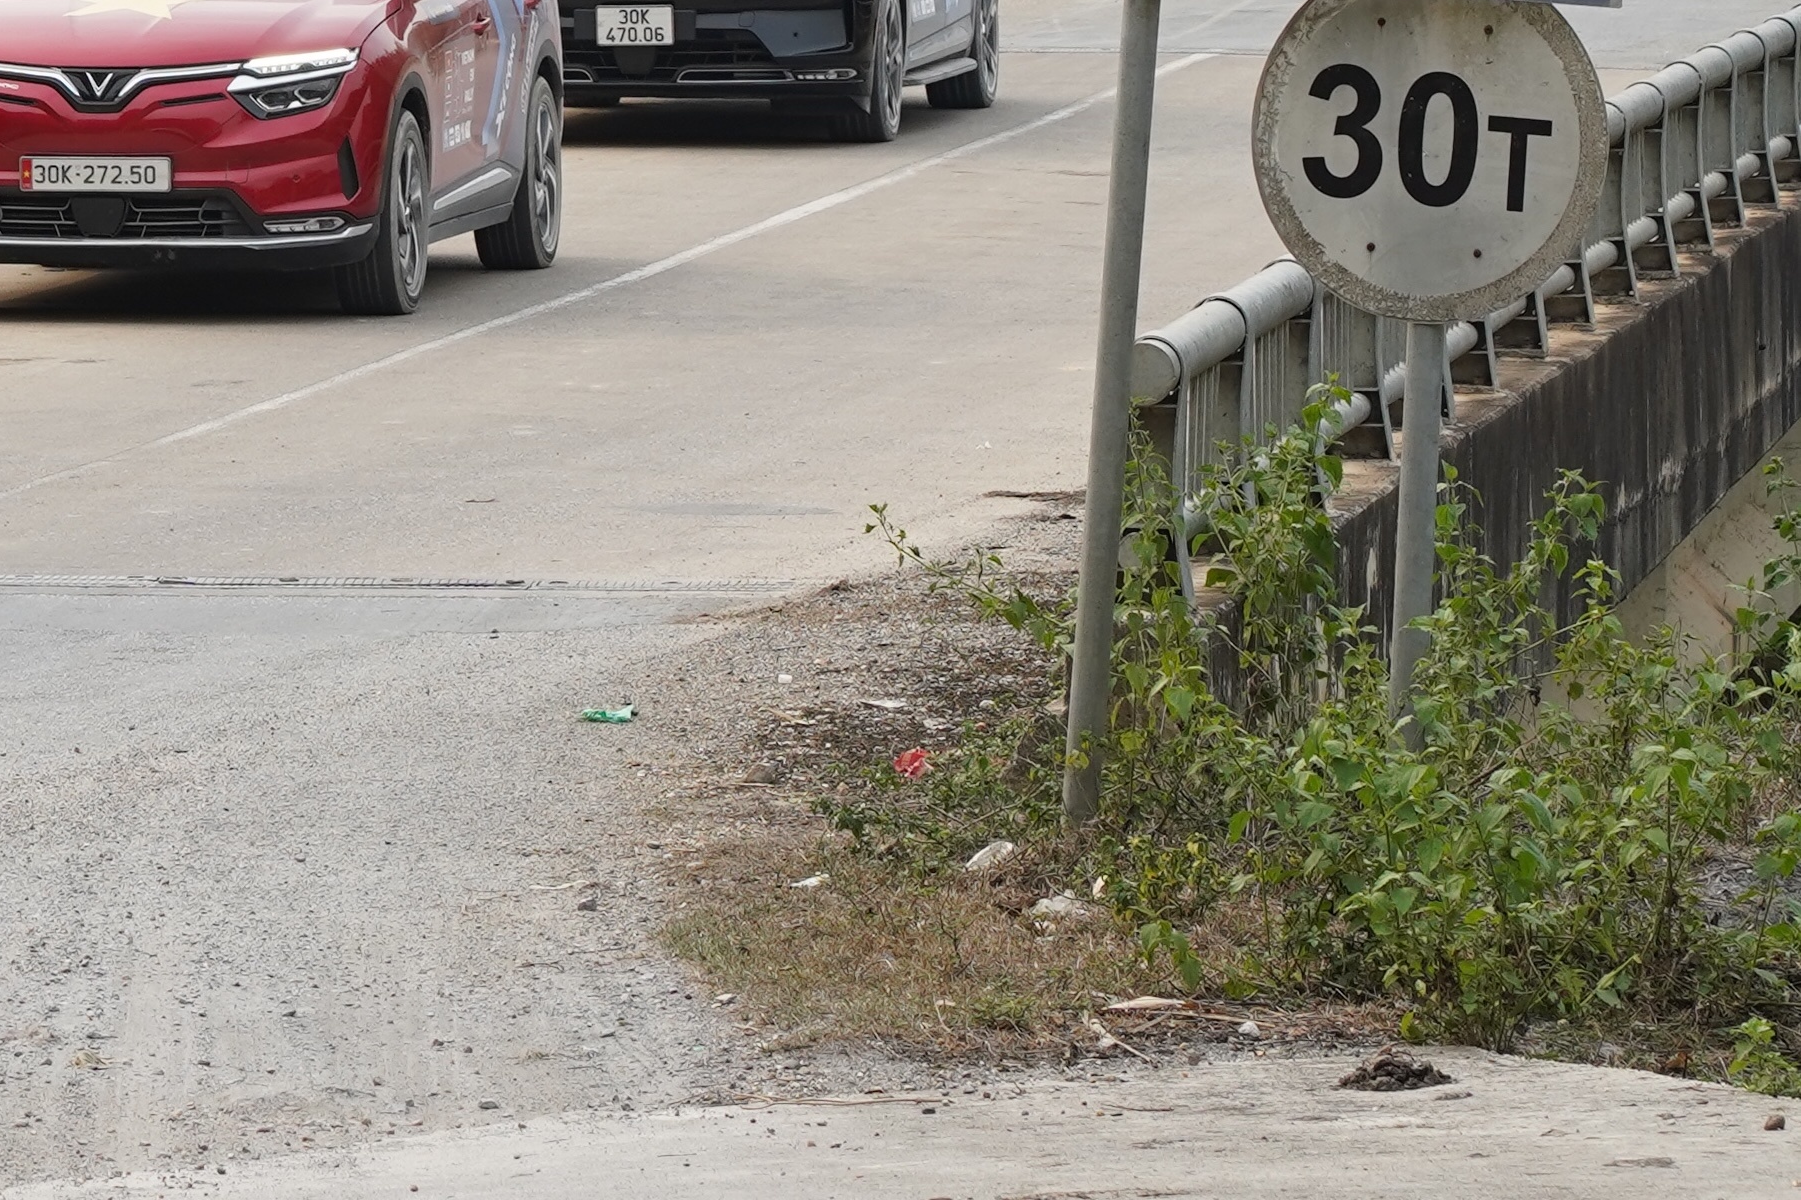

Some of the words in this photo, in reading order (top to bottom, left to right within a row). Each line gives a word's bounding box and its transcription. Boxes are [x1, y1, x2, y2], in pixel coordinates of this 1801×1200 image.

[618, 9, 650, 25] 30K
[606, 27, 665, 43] 470.06
[34, 164, 156, 185] 30K-272.50
